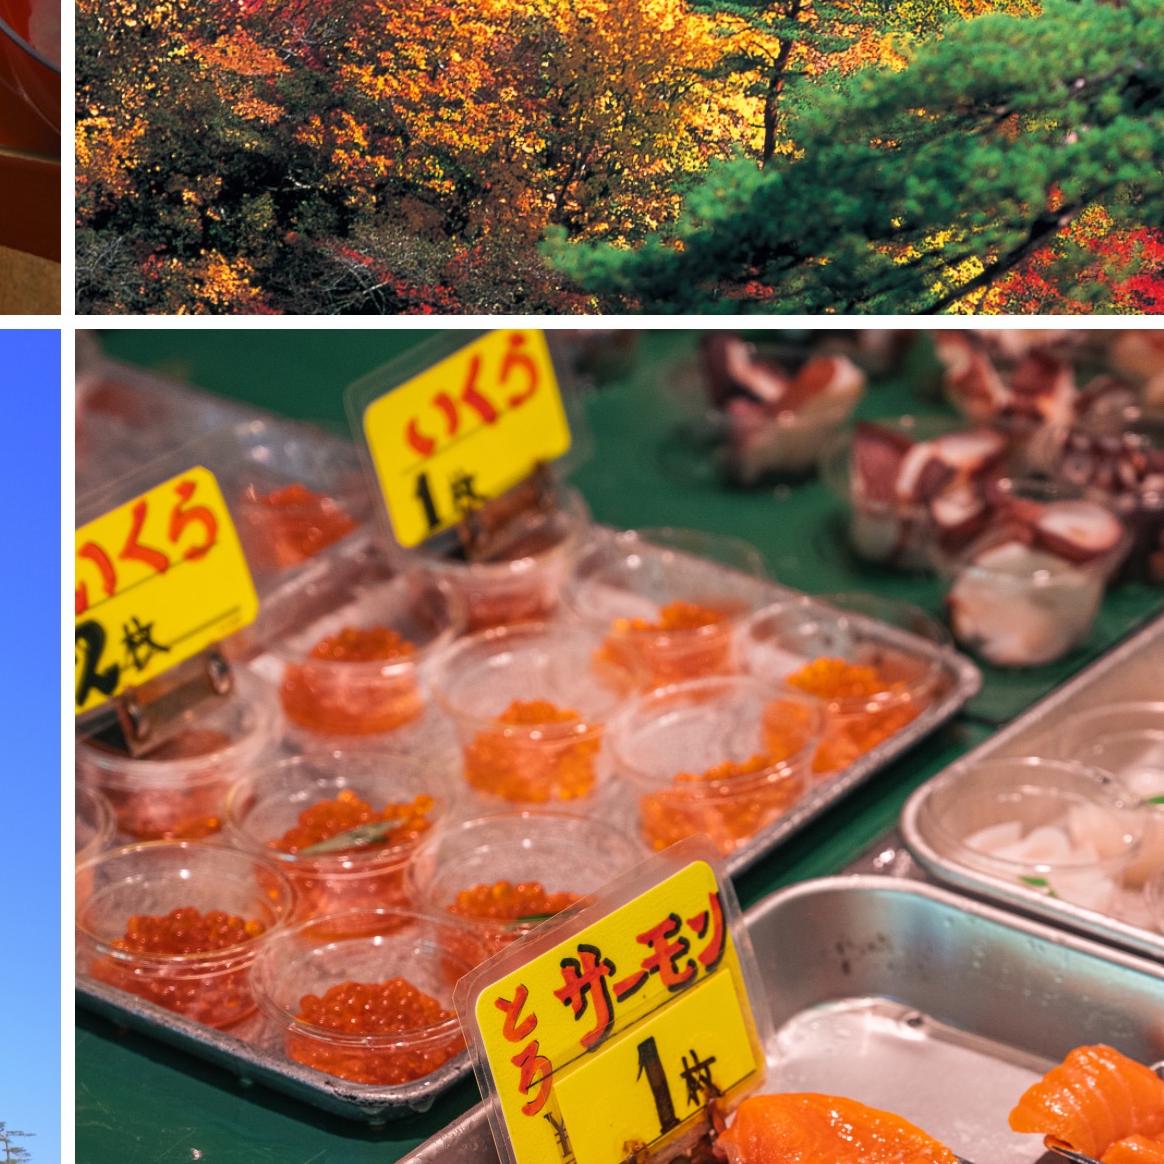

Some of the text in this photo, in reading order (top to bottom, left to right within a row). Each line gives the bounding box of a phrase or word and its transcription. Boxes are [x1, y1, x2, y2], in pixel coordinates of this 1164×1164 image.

[404, 332, 540, 458] いくら
[75, 615, 170, 706] 2枚
[554, 891, 726, 1053] サーモン
[495, 984, 553, 1117] とろ
[637, 1036, 723, 1135] 1枚
